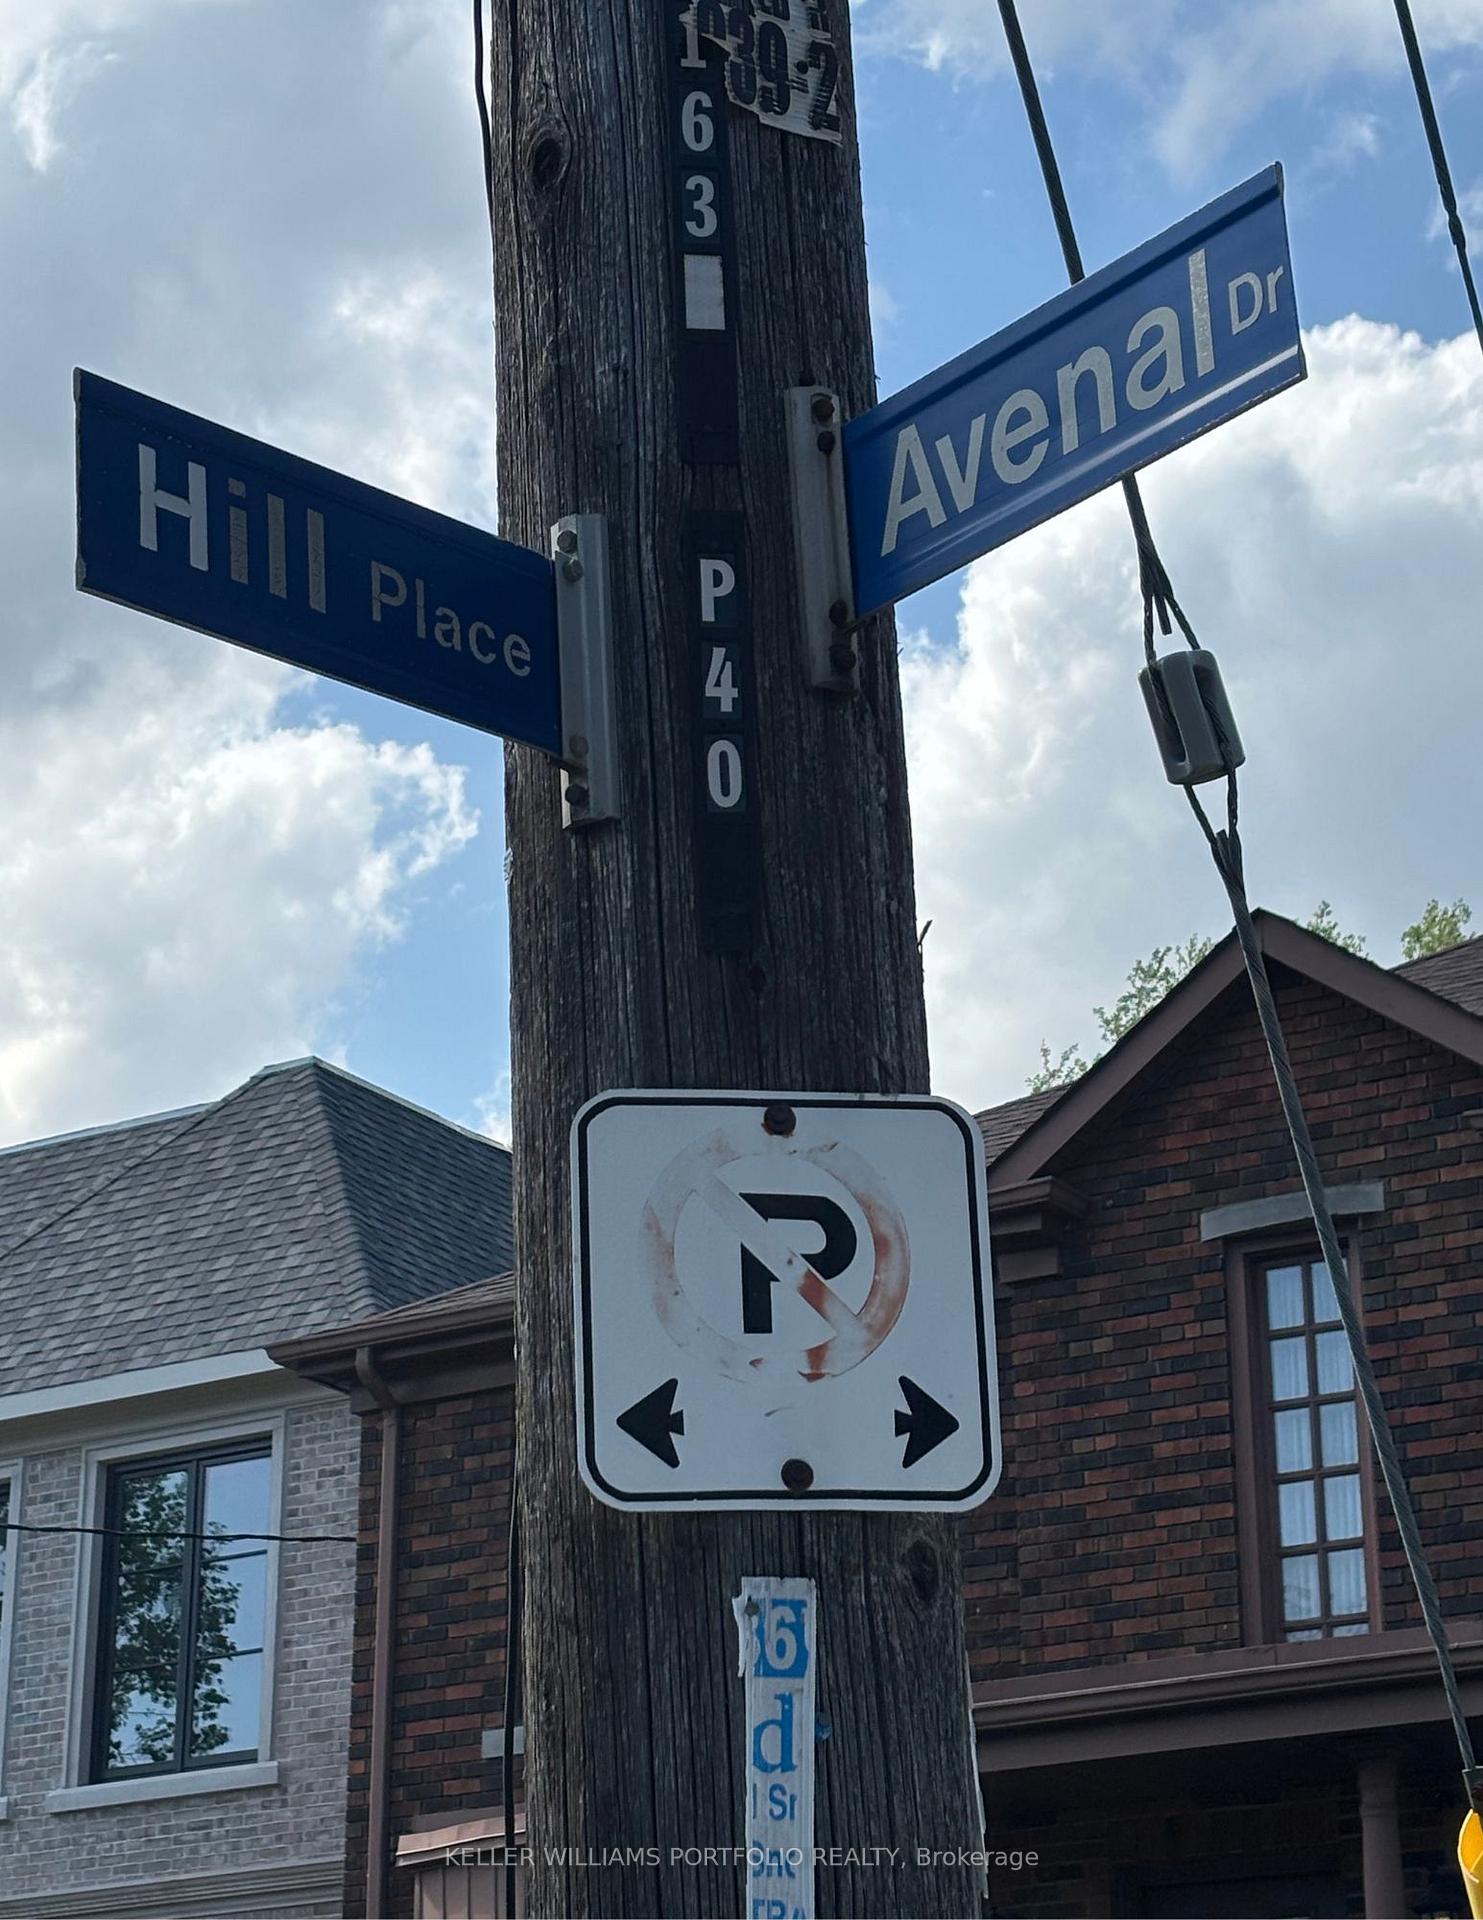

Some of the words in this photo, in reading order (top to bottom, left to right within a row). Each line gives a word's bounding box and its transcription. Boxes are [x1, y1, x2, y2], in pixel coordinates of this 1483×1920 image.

[880, 247, 1216, 558] Avenal
[1227, 264, 1285, 336] Dr
[137, 442, 327, 614] Hill
[370, 560, 531, 677] Place
